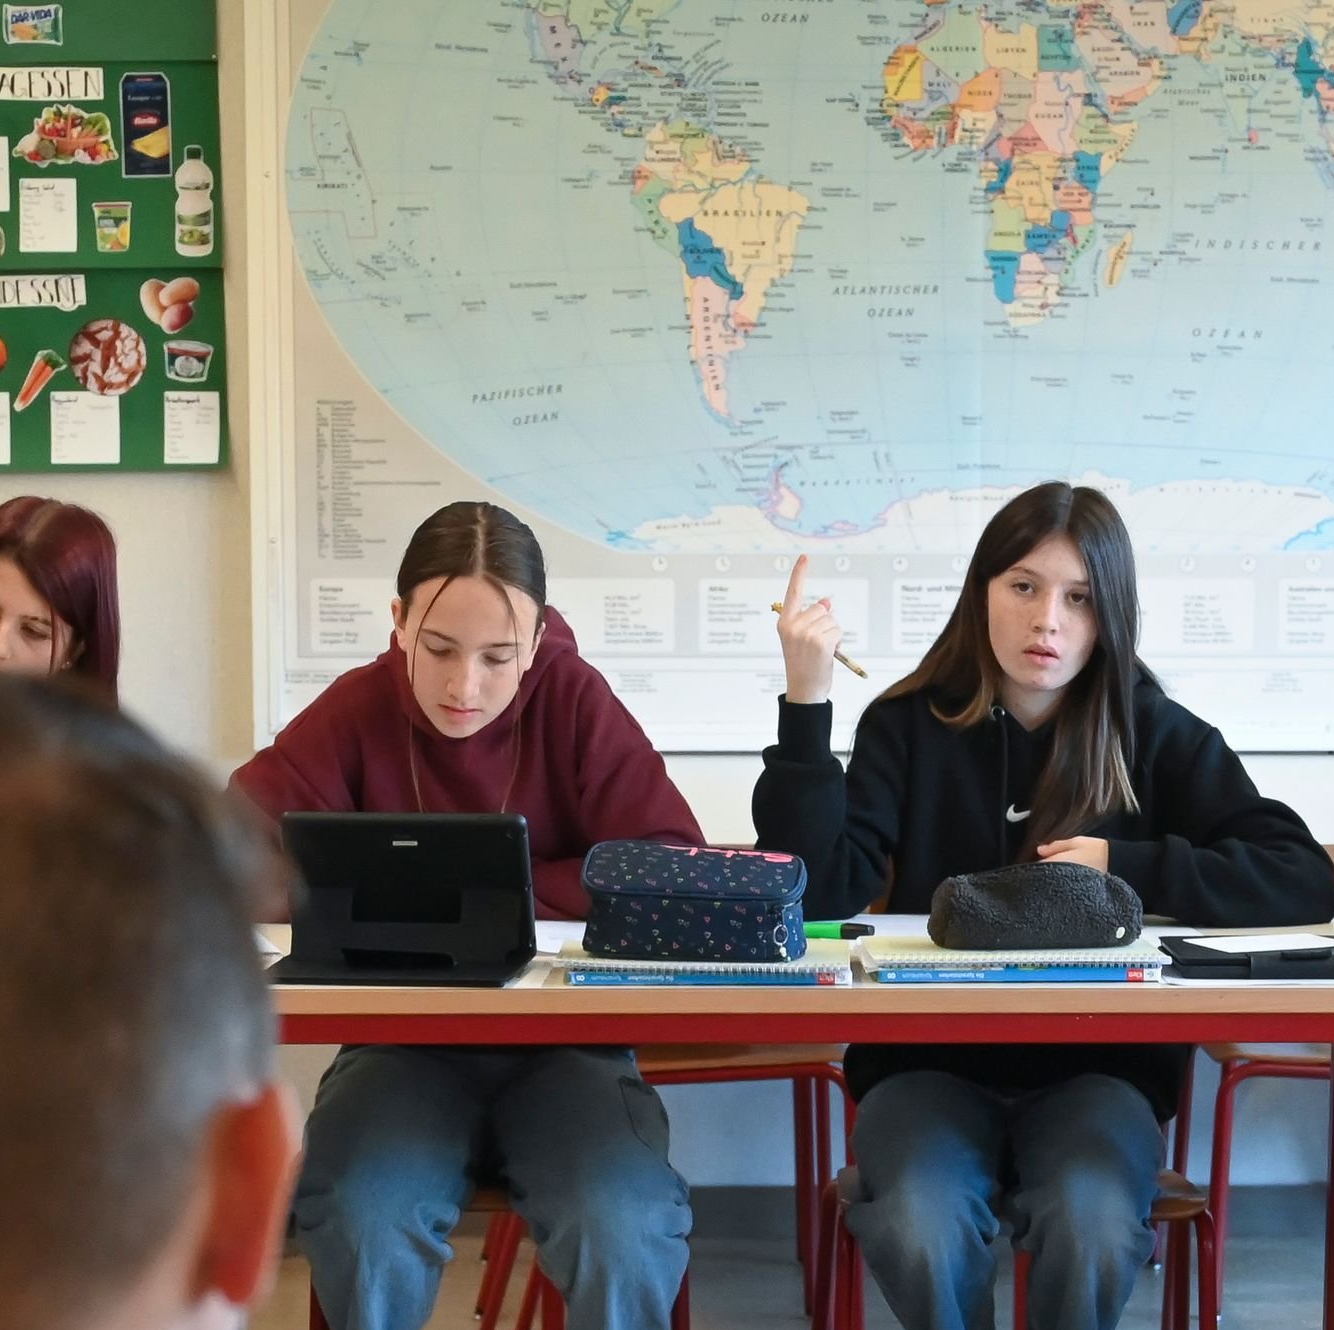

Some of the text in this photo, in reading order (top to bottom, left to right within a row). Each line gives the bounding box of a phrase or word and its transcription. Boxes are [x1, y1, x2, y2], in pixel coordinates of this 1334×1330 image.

[760, 12, 810, 23] OZEAN
[1225, 73, 1266, 83] INDIEN
[702, 210, 783, 218] BRASILIEN
[1194, 239, 1321, 251] INDISCHER
[832, 284, 940, 296] ATLANTISCHER
[867, 307, 915, 318] OZEAN
[1191, 327, 1264, 339] OZEAN
[471, 383, 564, 403] PAZIFISCHER
[512, 411, 560, 427] OZEAN
